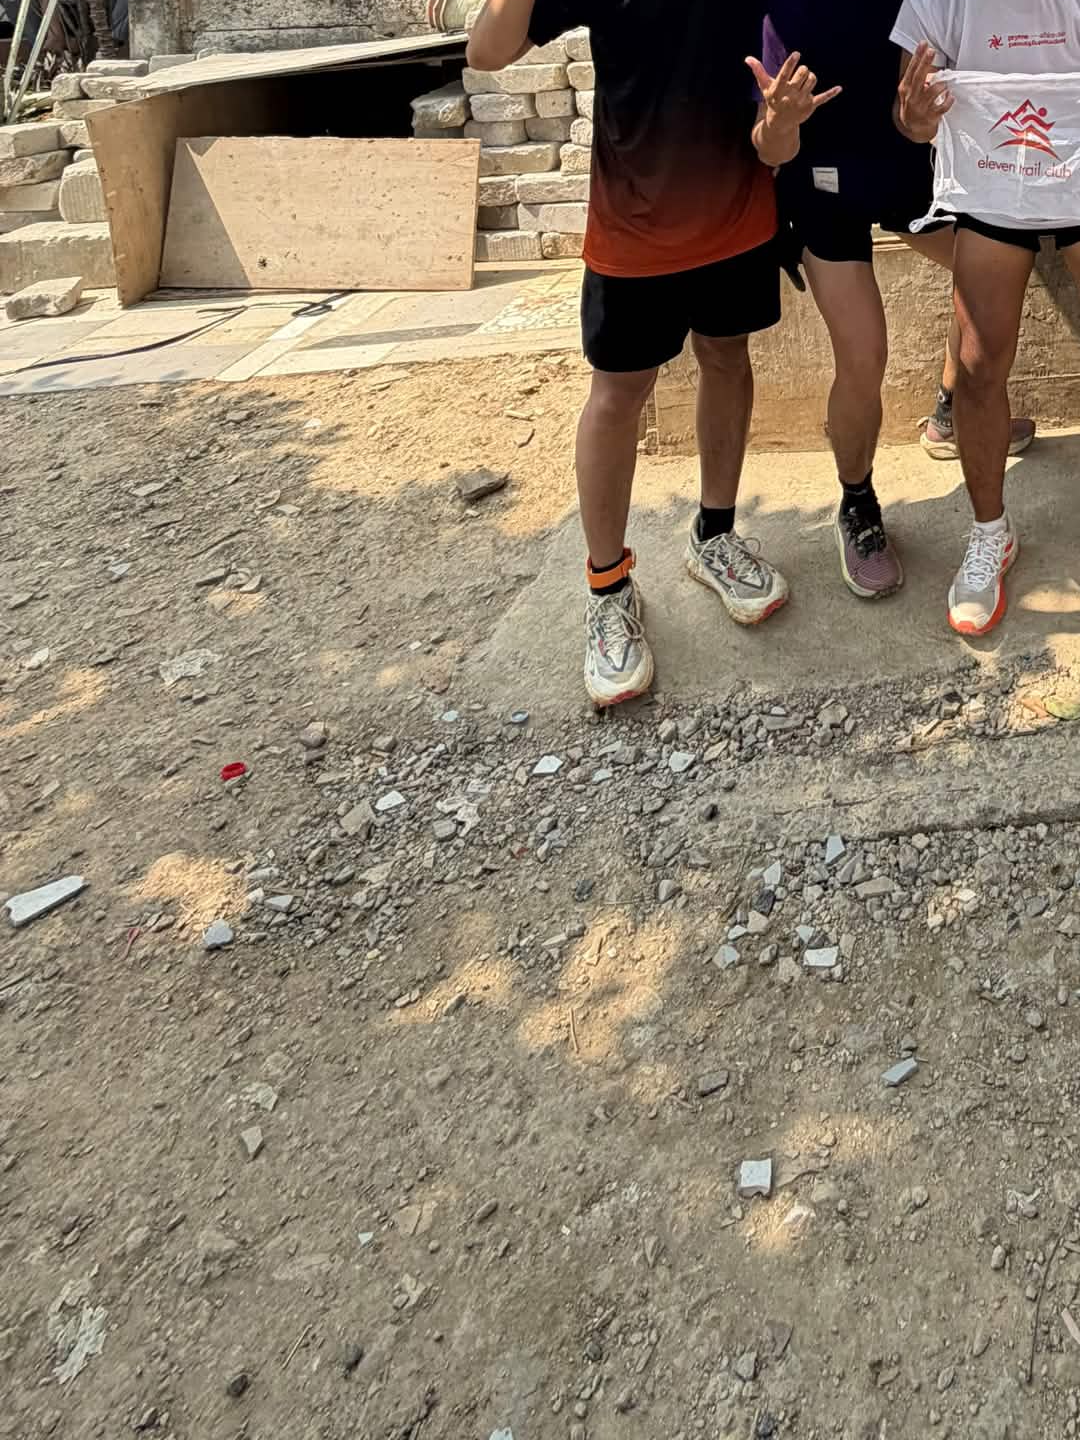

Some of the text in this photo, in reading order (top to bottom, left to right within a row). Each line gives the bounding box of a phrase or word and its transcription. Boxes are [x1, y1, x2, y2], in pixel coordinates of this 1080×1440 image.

[977, 154, 1072, 178] eleven trail club
